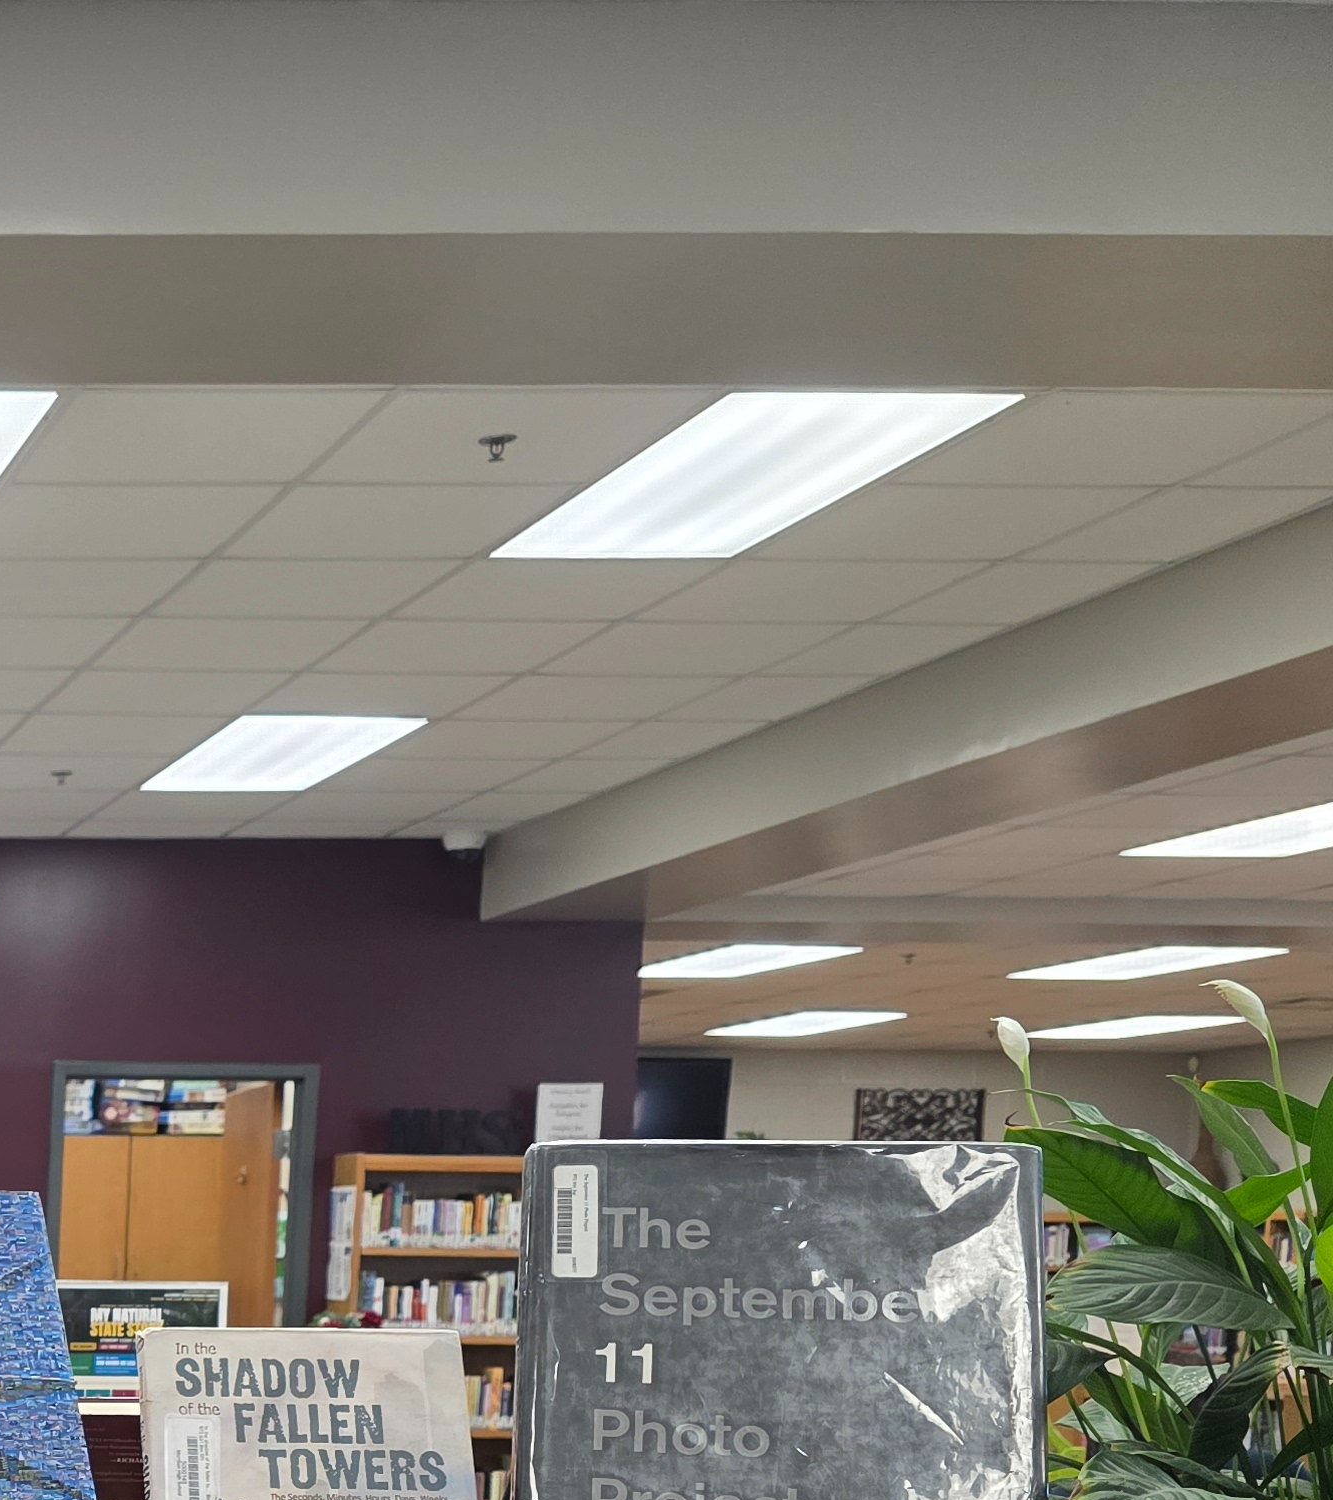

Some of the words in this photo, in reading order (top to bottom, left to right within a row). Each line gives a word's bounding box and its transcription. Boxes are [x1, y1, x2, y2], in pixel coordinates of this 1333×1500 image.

[602, 1207, 711, 1250] The
[90, 1308, 110, 1322] MY
[112, 1308, 163, 1322] NATURAL
[90, 1322, 125, 1337] STATE
[176, 1342, 191, 1355] In
[195, 1342, 217, 1355] the
[595, 1342, 653, 1385] 11
[175, 1358, 360, 1398] SHADOW
[179, 1402, 195, 1416] of
[198, 1402, 220, 1416] the
[234, 1403, 384, 1444] FALLEN
[592, 1409, 771, 1458] Photo
[258, 1448, 448, 1491] TOWERS
